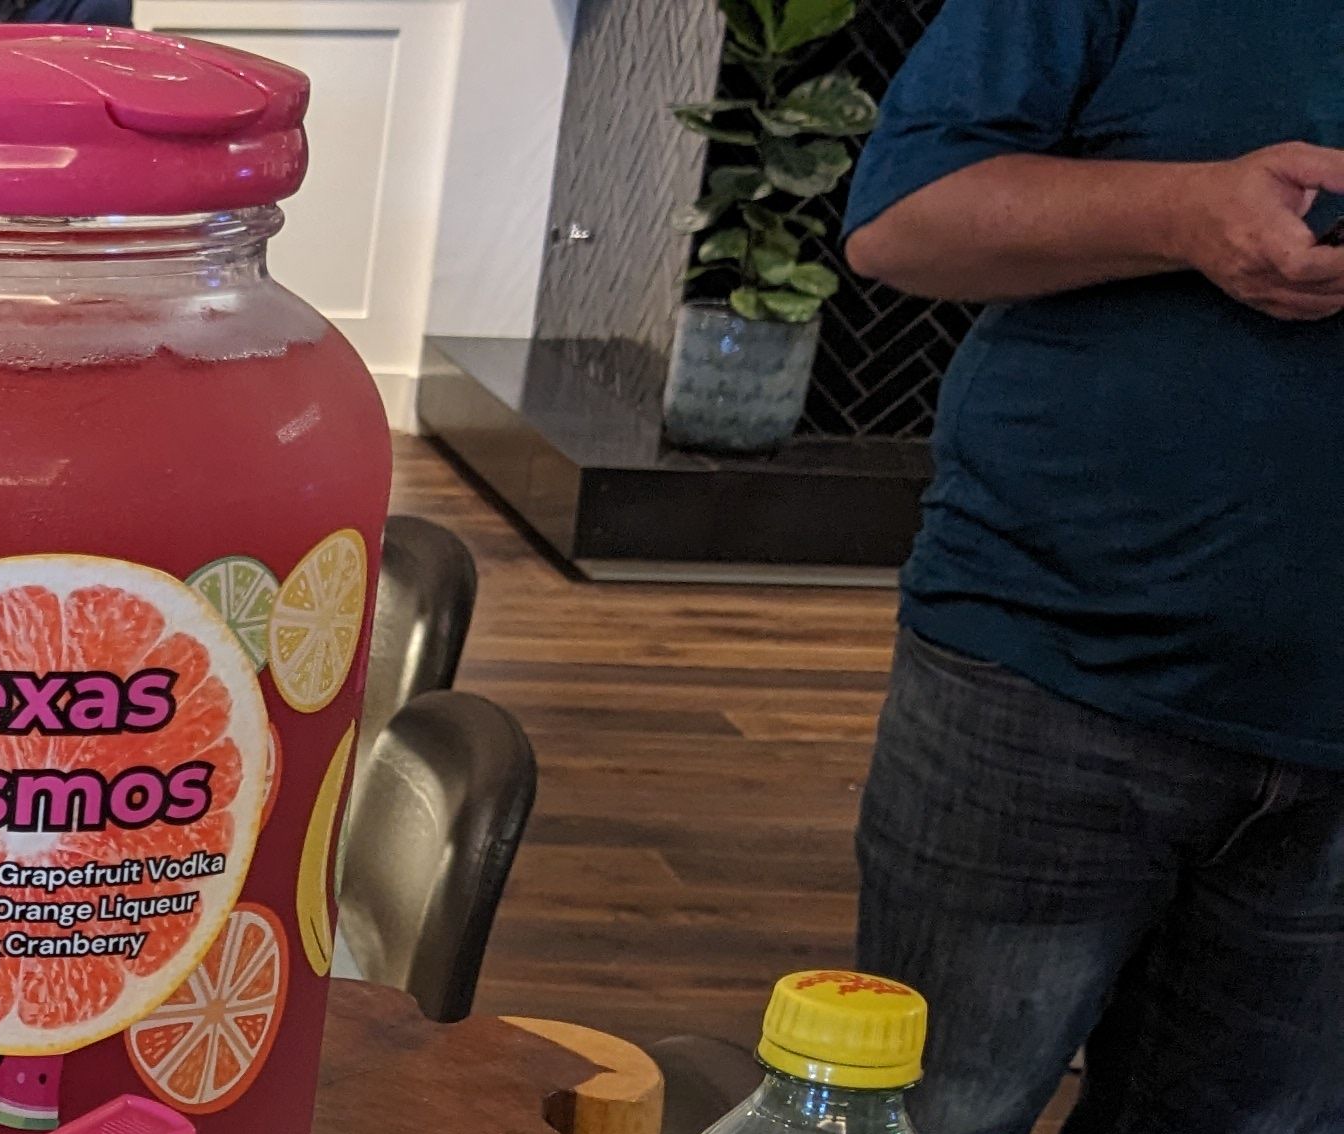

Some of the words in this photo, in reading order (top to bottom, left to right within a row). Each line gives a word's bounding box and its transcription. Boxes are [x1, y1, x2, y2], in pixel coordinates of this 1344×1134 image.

[145, 851, 225, 881] Vodka
[98, 891, 197, 926] Liqueur
[5, 930, 145, 960] Cranberry
